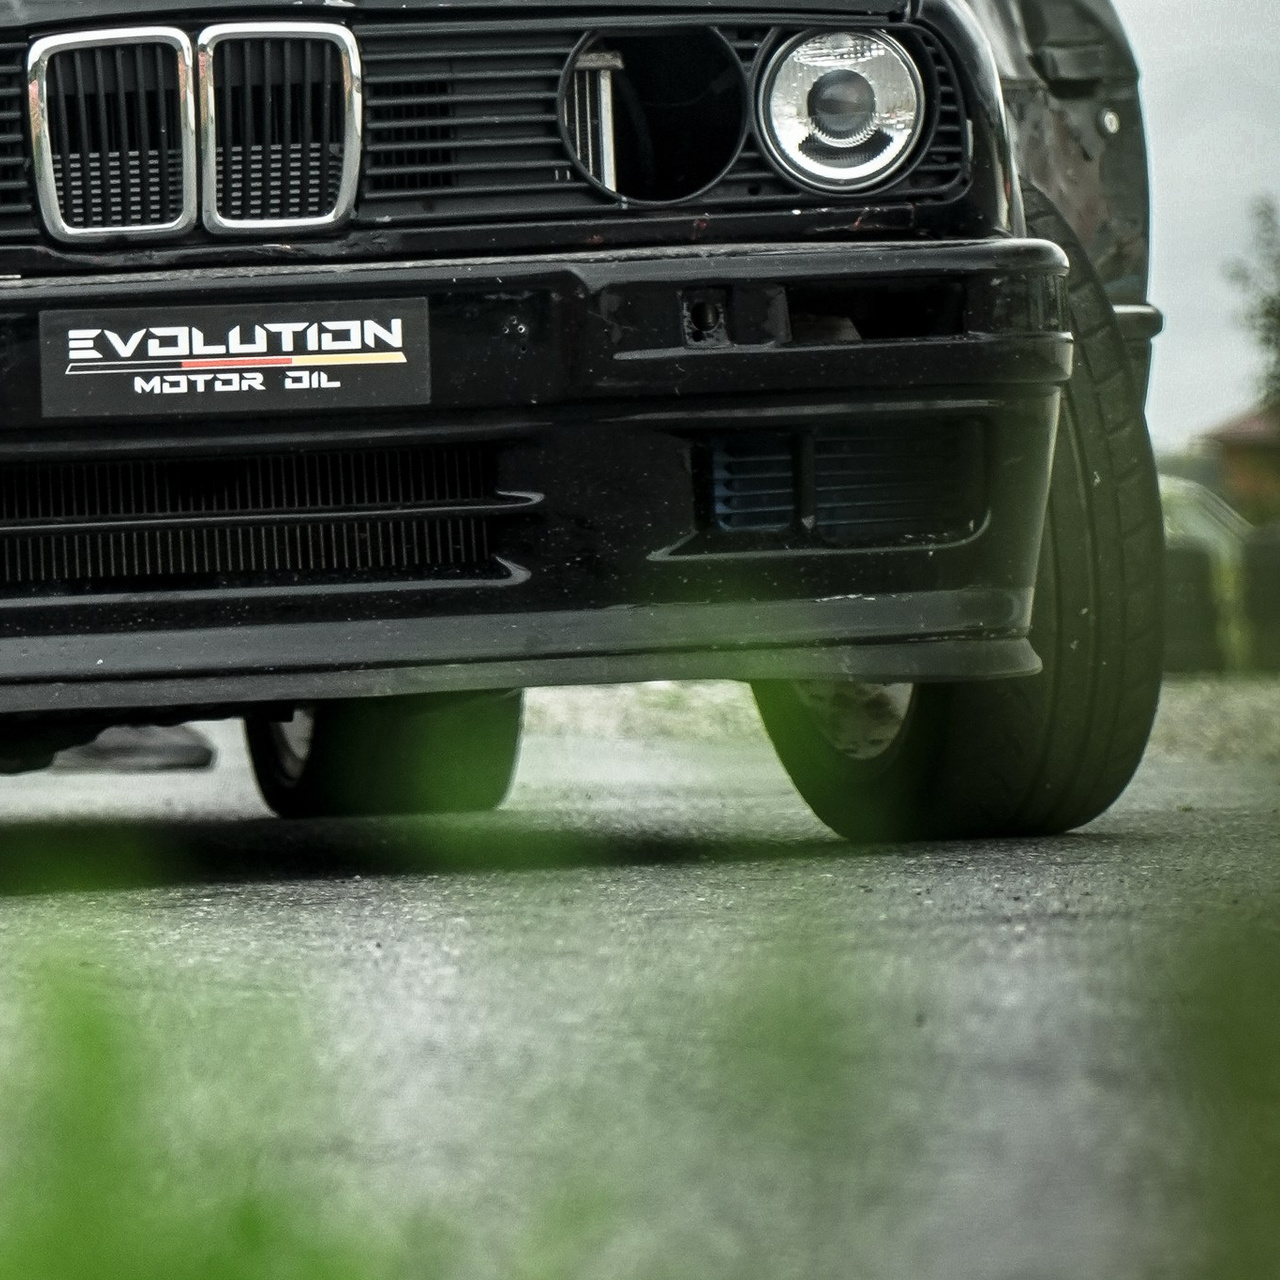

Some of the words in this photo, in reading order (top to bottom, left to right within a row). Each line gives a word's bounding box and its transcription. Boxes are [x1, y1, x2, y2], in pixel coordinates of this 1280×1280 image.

[68, 318, 402, 359] EVOLUTION
[134, 372, 265, 394] MOTOR
[284, 370, 341, 389] OIL
